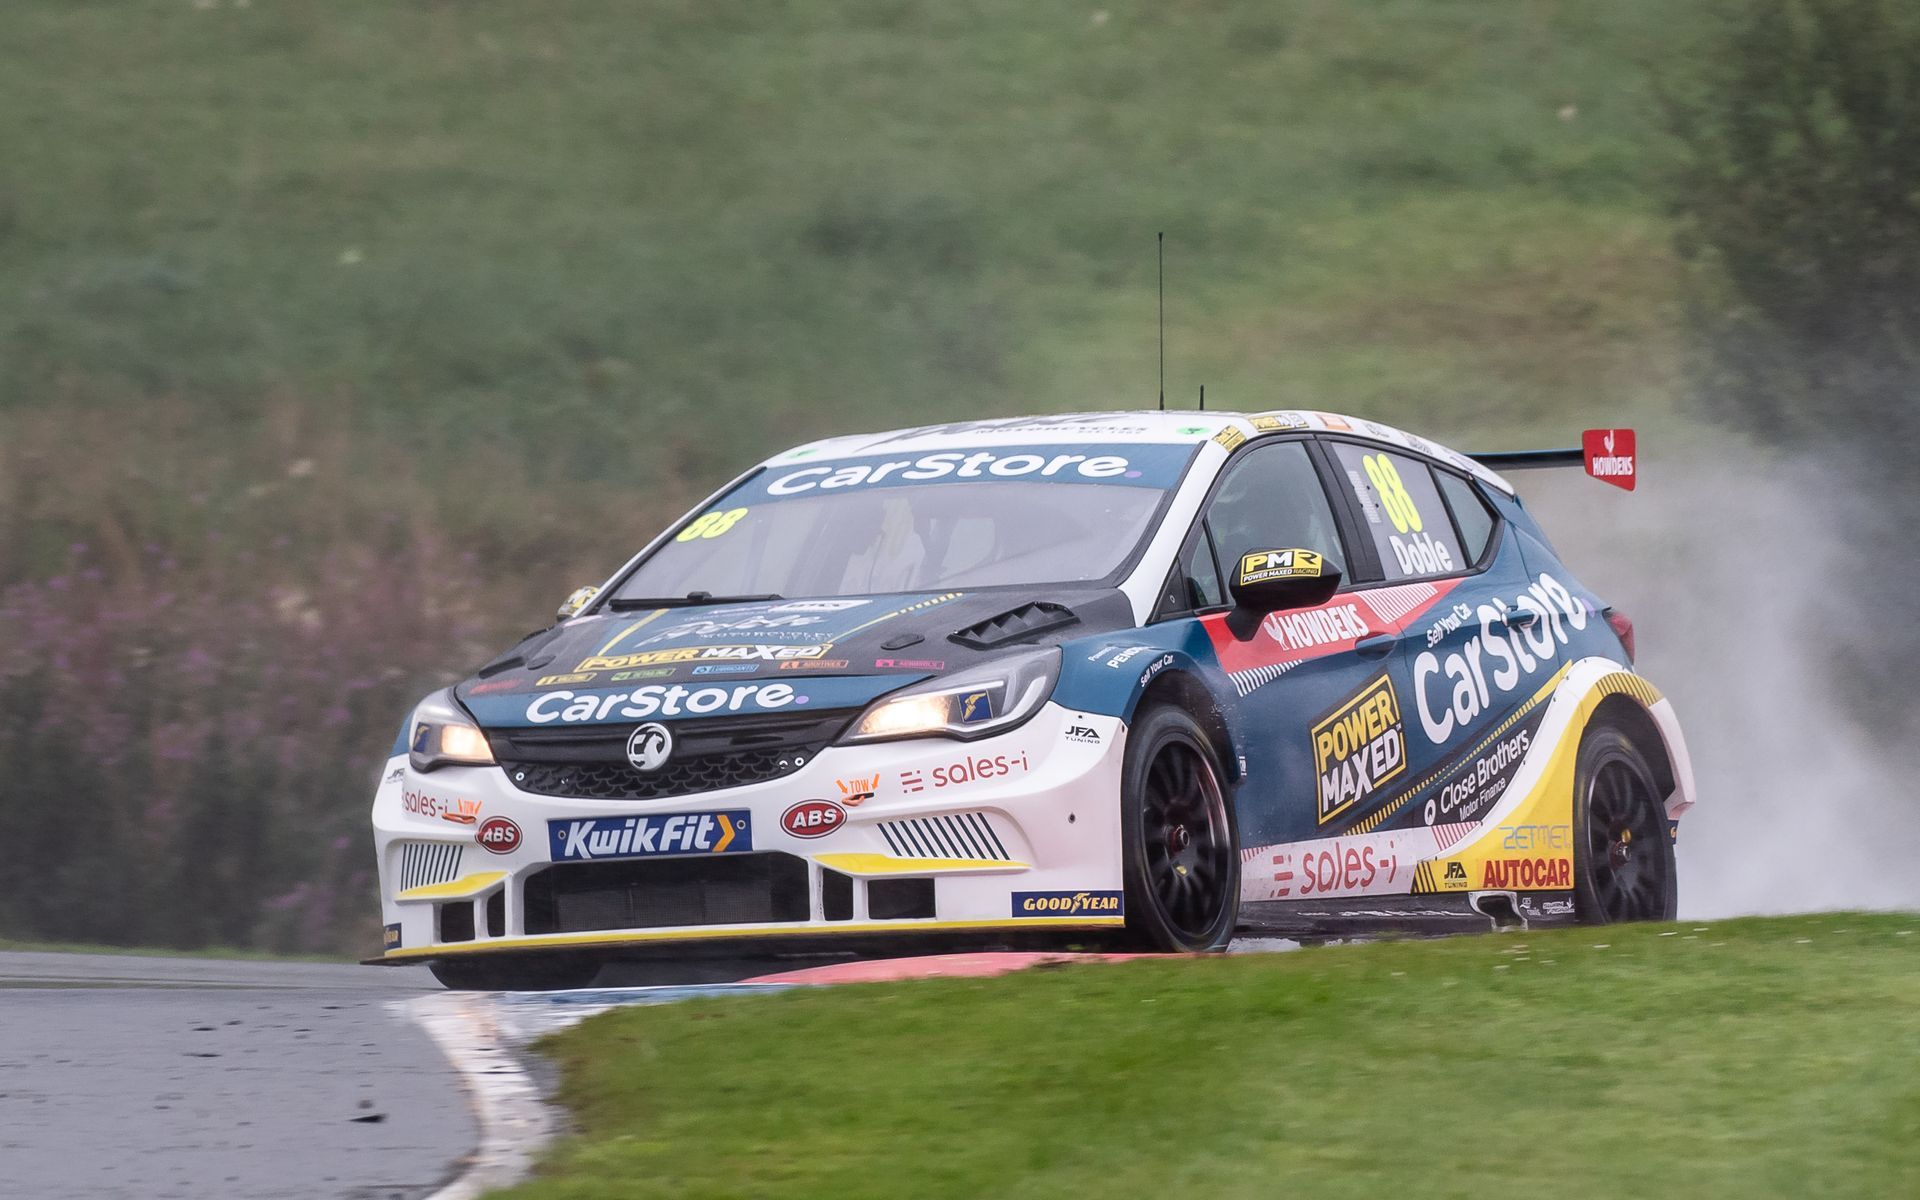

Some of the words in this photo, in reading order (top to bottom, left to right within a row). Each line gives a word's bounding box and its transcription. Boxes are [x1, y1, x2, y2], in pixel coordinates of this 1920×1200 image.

[766, 451, 1128, 496] CarStore
[1592, 455, 1634, 477] HOWDENS
[1362, 453, 1424, 534] 88
[675, 506, 749, 542] 88
[1245, 551, 1318, 574] PMR
[1388, 531, 1453, 577] Doble
[1243, 571, 1268, 582] POWER
[1268, 568, 1293, 577] MAXED
[1293, 567, 1318, 575] RACING
[1283, 602, 1369, 649] HOWDENS
[1426, 622, 1444, 649] Sell
[1440, 615, 1462, 635] Your
[1452, 603, 1473, 620] Car
[583, 648, 699, 669] POWER
[699, 643, 825, 661] MAXED
[1163, 654, 1174, 666] Car
[525, 682, 796, 723] CarStore
[1064, 726, 1101, 739] JFA
[1064, 737, 1101, 745] TUNING
[1317, 688, 1399, 774] POWER
[931, 750, 1029, 787] sales-i
[1320, 727, 1402, 814] MAXED
[1440, 770, 1477, 815] Close
[1475, 728, 1531, 787] Brothers
[404, 789, 449, 817] sales-i
[848, 780, 870, 794] TOW
[1459, 797, 1480, 823] Motor
[1478, 776, 1507, 809] Finance
[792, 807, 838, 829] ABS
[481, 827, 516, 845] ABS
[1300, 840, 1398, 896] sales-i
[1443, 861, 1468, 880] JFA
[1483, 857, 1571, 890] AUTOCAR
[1443, 881, 1468, 890] TUNING
